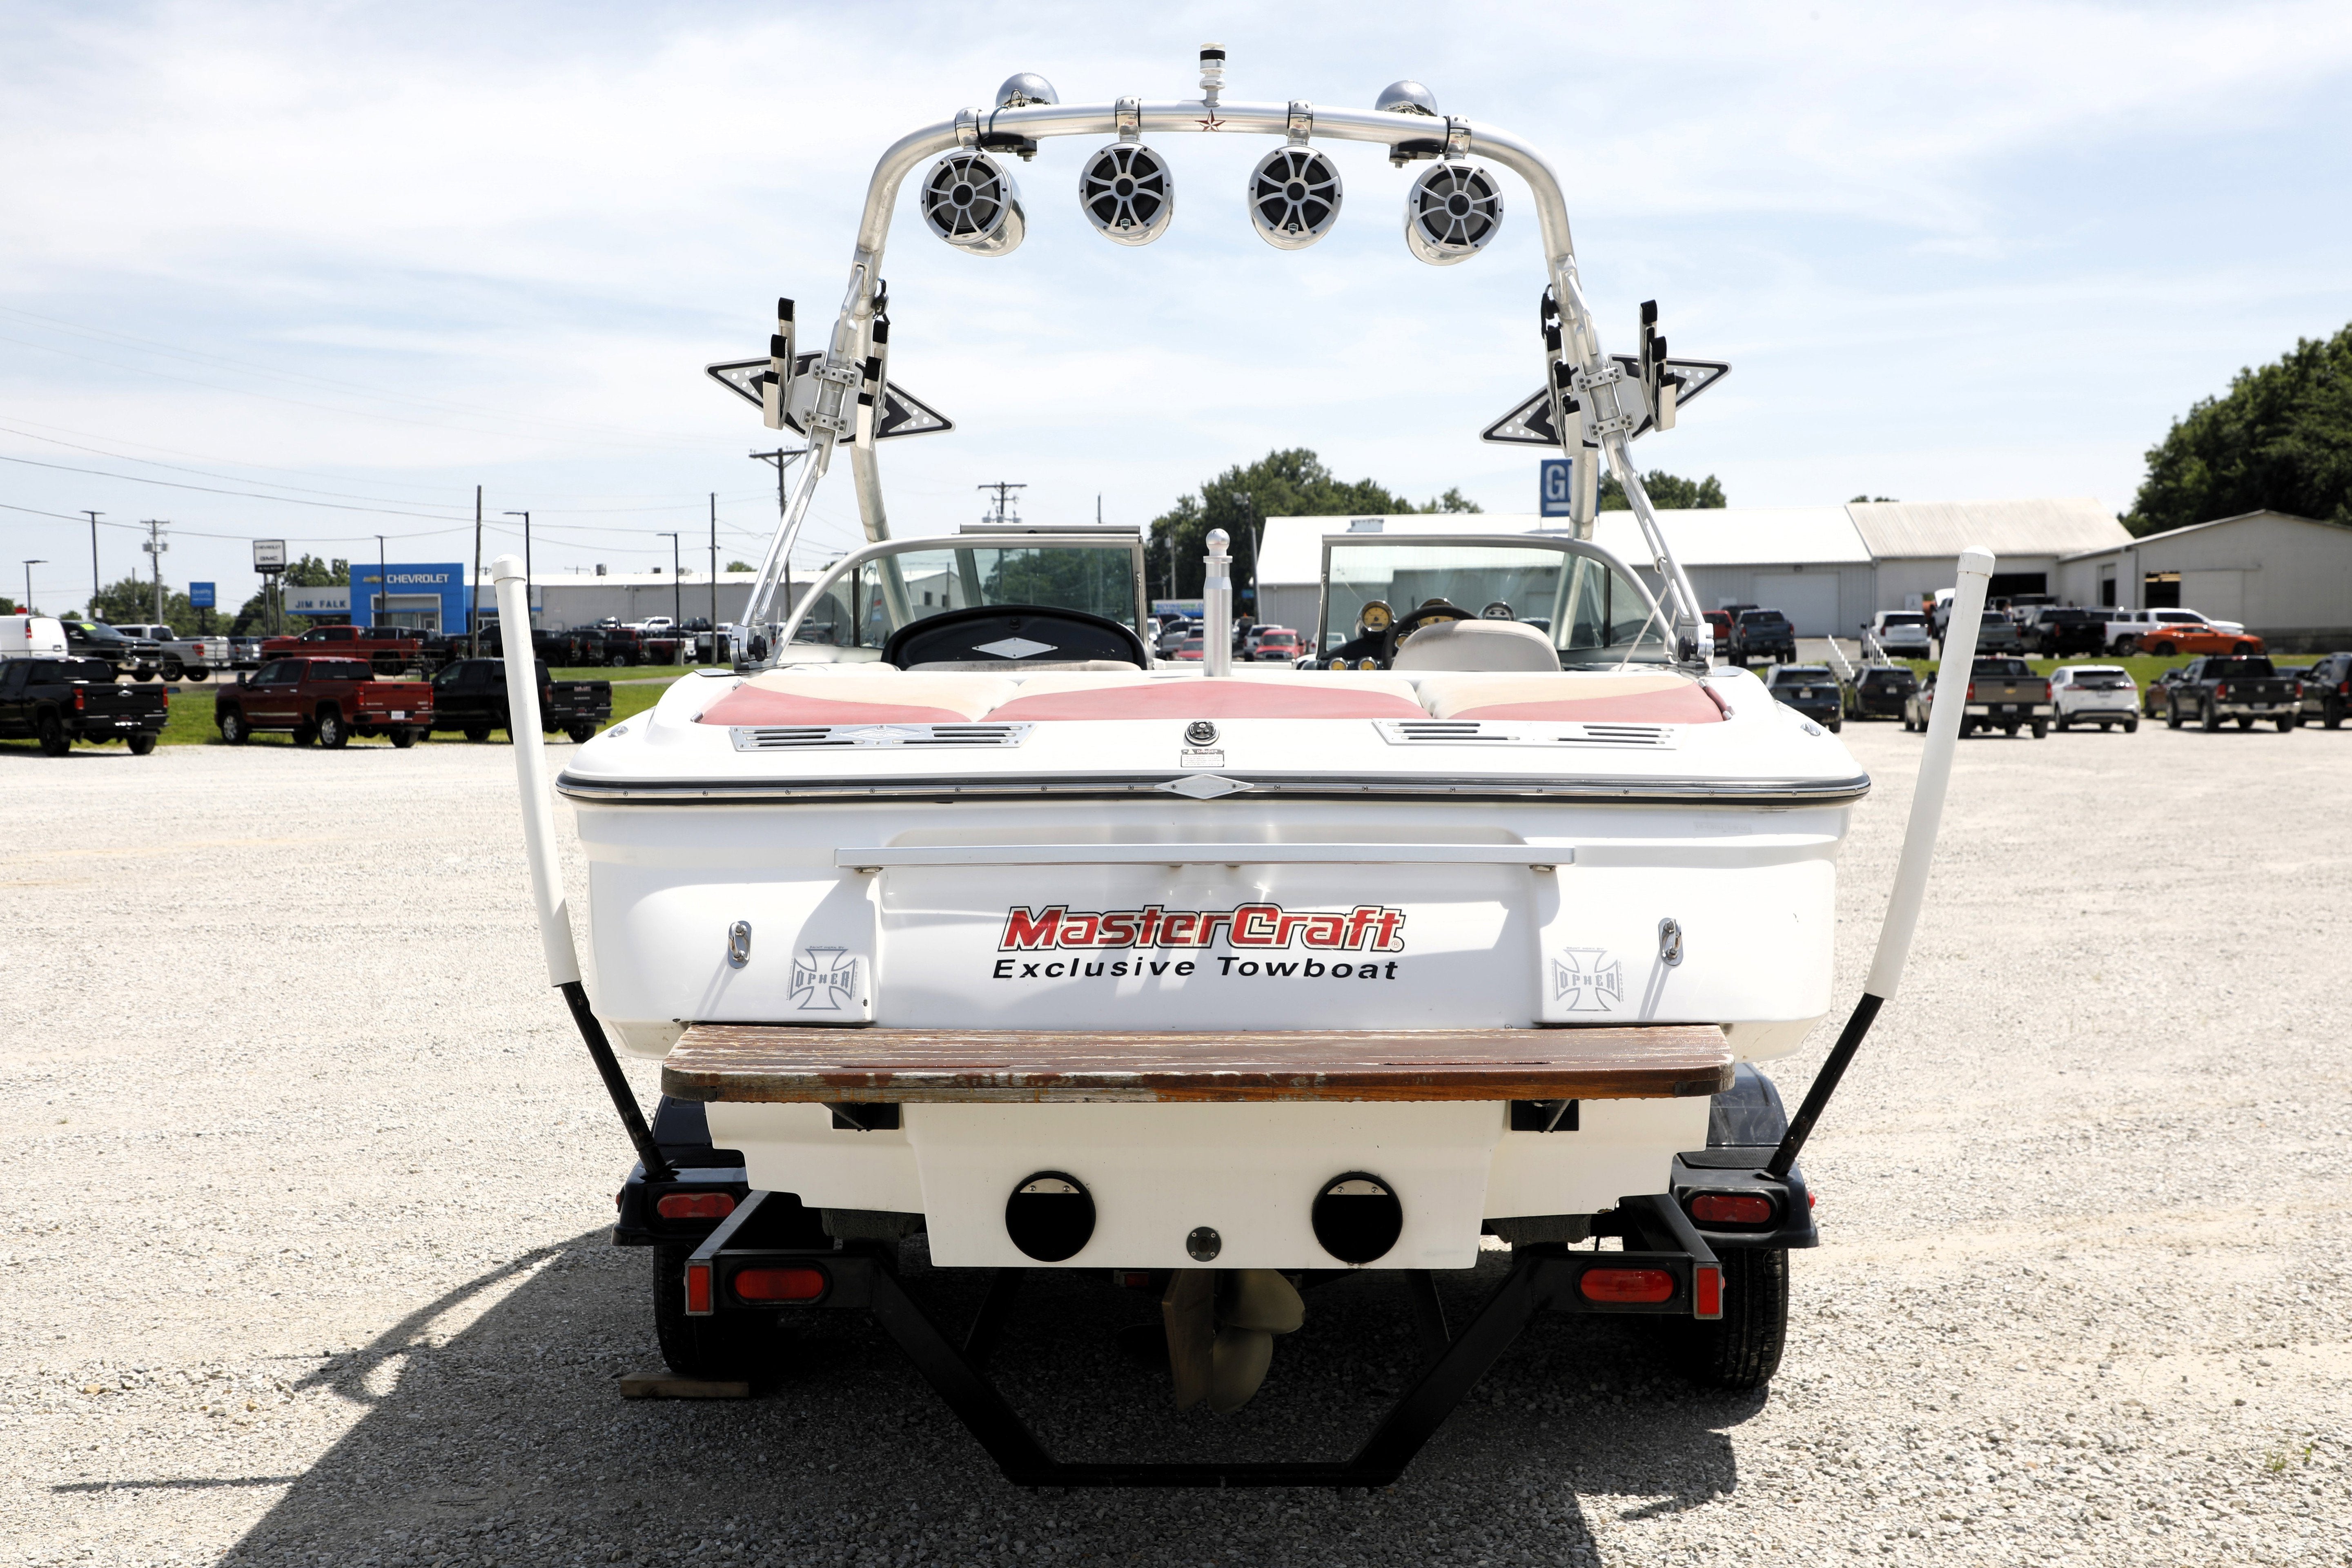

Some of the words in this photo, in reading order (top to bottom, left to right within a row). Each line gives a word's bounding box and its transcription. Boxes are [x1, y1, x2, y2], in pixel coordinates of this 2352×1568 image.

[387, 574, 449, 584] CHEVROLET
[993, 957, 1195, 978] Exclusive
[1217, 957, 1398, 979] Towboat
